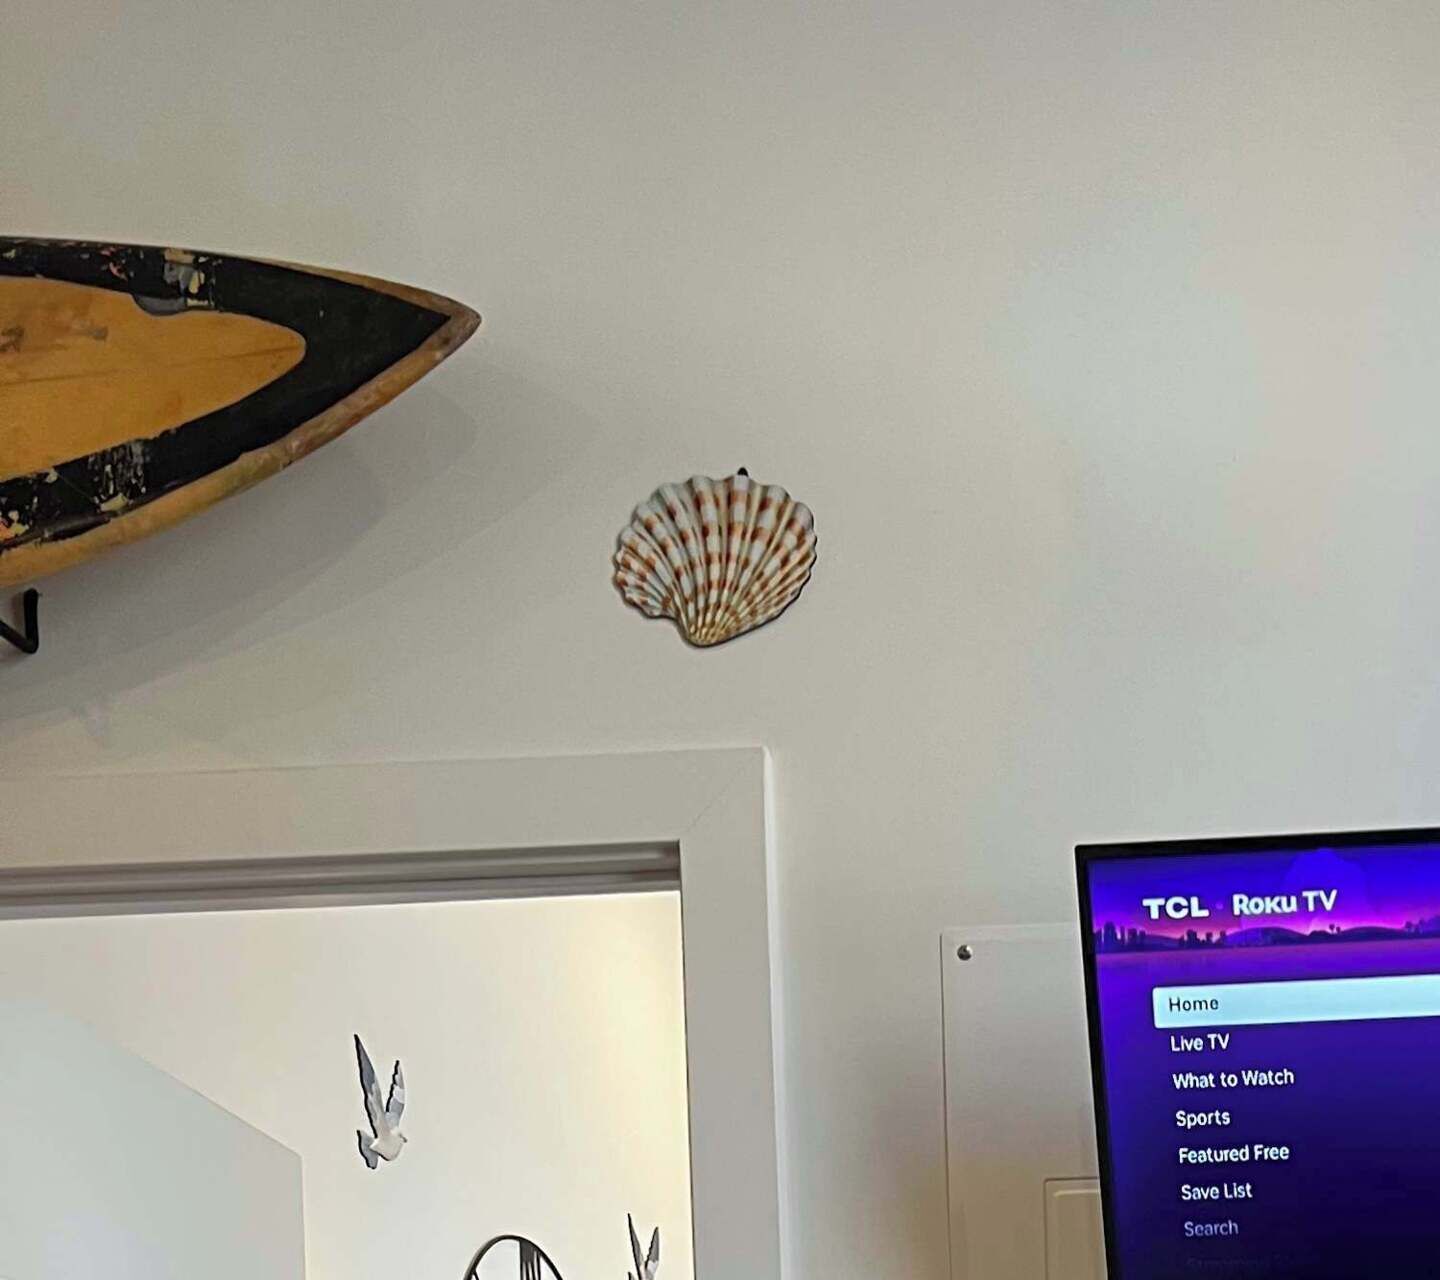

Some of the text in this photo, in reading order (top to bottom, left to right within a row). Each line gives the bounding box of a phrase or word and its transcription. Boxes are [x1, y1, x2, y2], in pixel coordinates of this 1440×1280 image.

[1142, 897, 1209, 920] TCL
[1233, 889, 1338, 916] Roku TV
[1168, 997, 1219, 1012] Home
[1170, 1034, 1230, 1052] Live TV
[1172, 1069, 1295, 1090] What to Watch
[1175, 1109, 1231, 1129] Sports
[1178, 1144, 1290, 1164] Featured Free
[1181, 1182, 1253, 1200] Save List
[1184, 1219, 1239, 1237] Search
